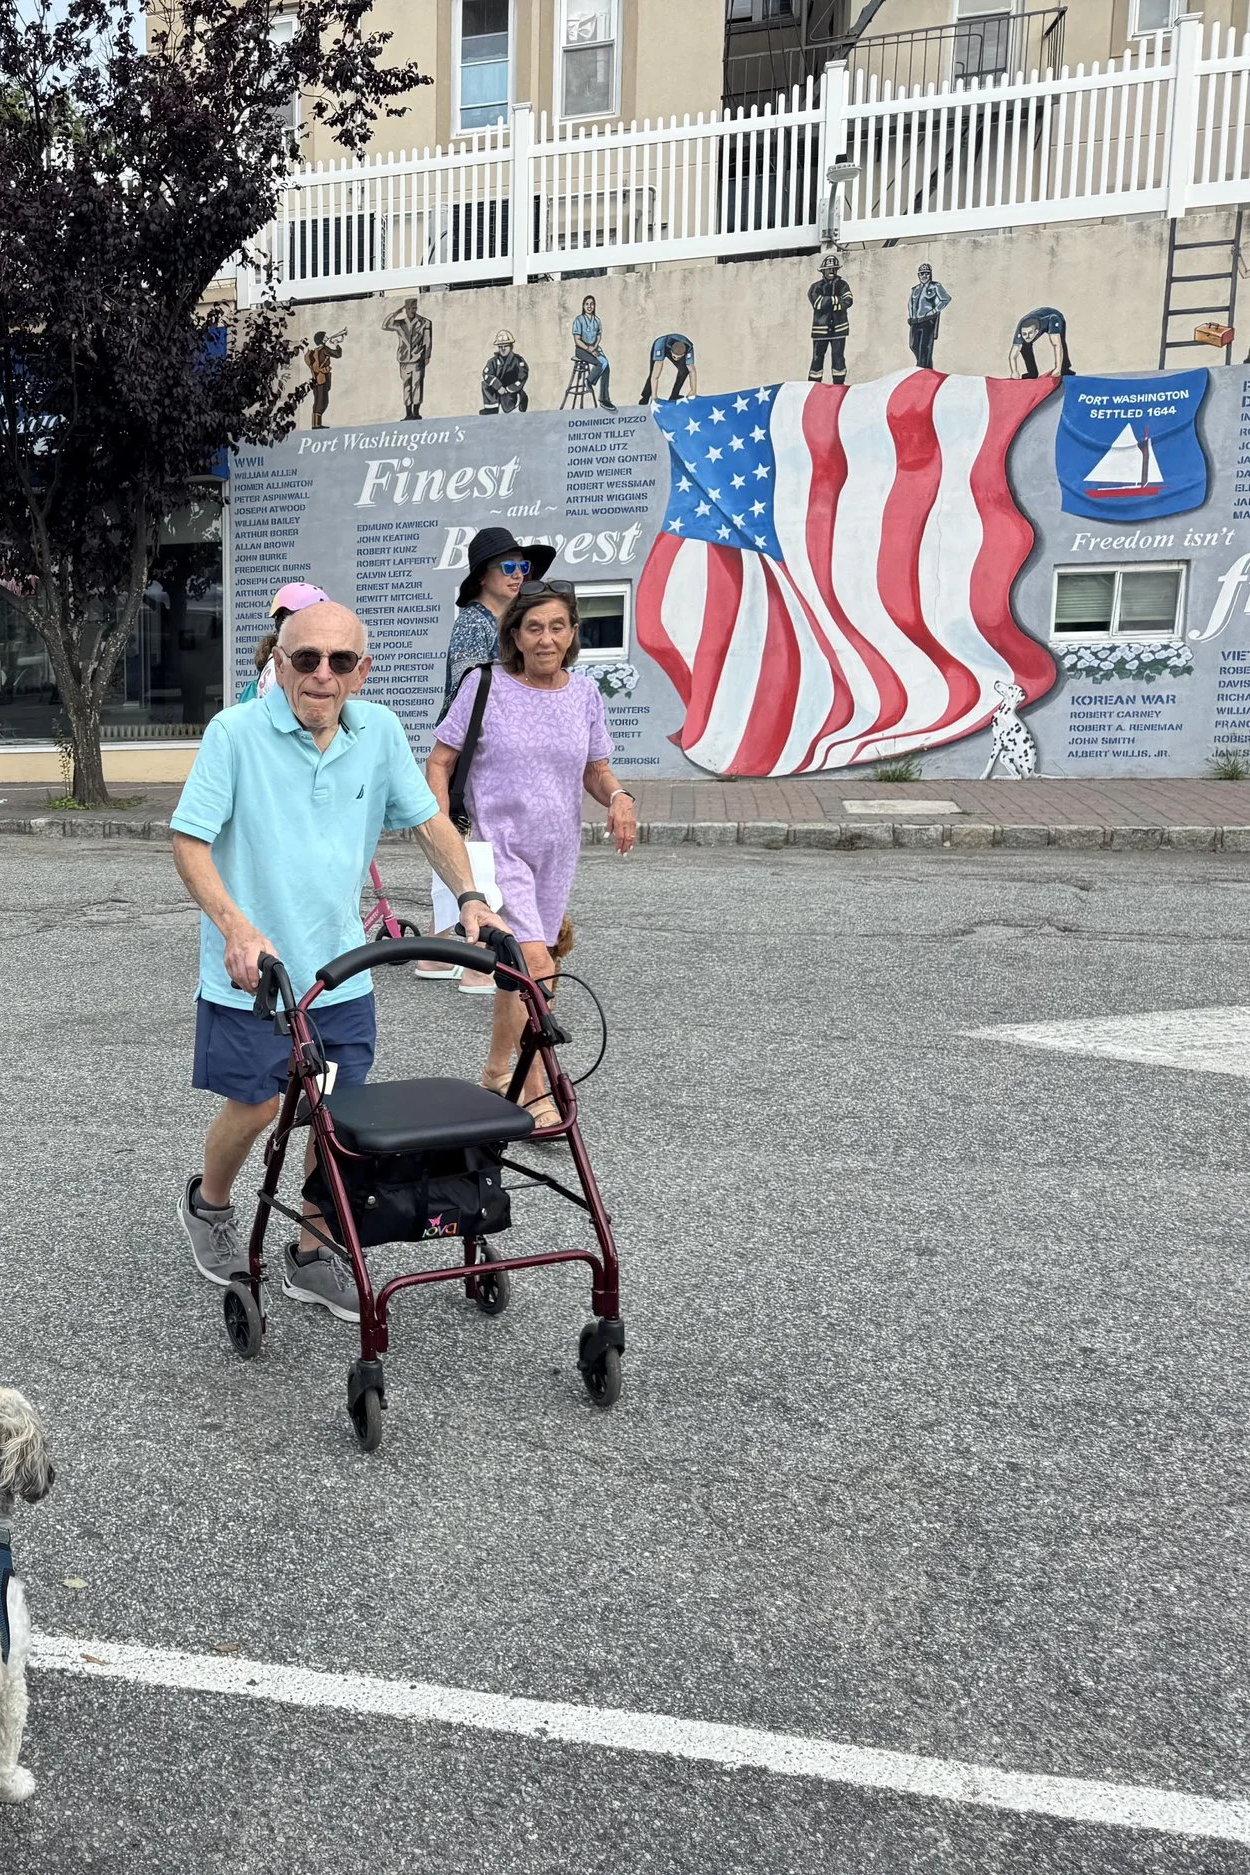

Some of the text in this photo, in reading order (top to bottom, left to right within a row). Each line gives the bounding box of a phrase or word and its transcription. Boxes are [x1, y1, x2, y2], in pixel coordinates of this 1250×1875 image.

[1078, 389, 1189, 405] PORT WASHINGTON
[1090, 406, 1177, 419] SETTLED 1644
[568, 415, 647, 428] DOMINICK PIZZO
[298, 425, 466, 454] Port Washington's
[568, 429, 635, 441] MILTON TILLEY
[567, 442, 628, 454] DONALD UTZ
[234, 456, 264, 468] WWII
[567, 453, 658, 466] JOHN VON GONTEN
[234, 468, 298, 480] WILLIAM ALLEN
[567, 467, 632, 479] DAVID WEINER
[234, 480, 314, 492] HOMER ALLINGTON
[354, 455, 522, 508] Finest
[566, 479, 656, 491] ROBERT WESSMAN
[234, 492, 310, 504] PETER ASPINWALL
[566, 492, 648, 504] ARTHUR WIGGINS
[234, 504, 306, 516] JOSEPH ATWOOD
[507, 501, 541, 518] and
[565, 505, 649, 517] PAUL WOODWARD
[234, 516, 301, 528] WILLIAM BAILEY
[356, 519, 438, 532] EDMUND KAWIECKI
[234, 528, 299, 539] ARTHUR BORER
[356, 533, 420, 544] JOHN KEATING
[1070, 526, 1236, 552] Freedom isn't
[234, 540, 295, 551] ALLAN BROWN
[356, 545, 418, 556] ROBERT KUNZ
[433, 520, 643, 571] Bvest
[235, 552, 288, 562] JOHN BURKE
[356, 556, 437, 568] ROBERT LAFFERTY
[234, 563, 311, 574] FREDERICK BURNS
[356, 569, 412, 580] CALVIN LEITZ
[235, 575, 305, 586] JOSEPH CARUSO
[356, 581, 423, 592] ERNEST MAZUR
[235, 589, 268, 597] ARTHUR
[356, 593, 433, 603] HEWITT MITCHELL
[235, 600, 271, 609] NICHOLA
[355, 604, 441, 615] CHESTER NAKELSKI
[235, 612, 262, 620] JAMES
[362, 616, 439, 626] HESTER NOVINSKI
[235, 624, 275, 632] ANTHONY
[376, 628, 429, 637] PERDREAUX
[383, 641, 413, 649] POOLE
[398, 651, 447, 660] PORCIELLO
[369, 663, 434, 673] WALD PRESTON
[391, 675, 429, 683] RICHTER
[355, 686, 444, 696] RANK ROGOZENSKI
[392, 699, 435, 707] ROSEBRO
[1071, 694, 1176, 706] KOREAN WAR
[608, 706, 650, 714] WINTERS
[1070, 711, 1162, 719] ROBERT CARNEY
[1069, 724, 1113, 732] ROBERT
[1101, 737, 1136, 745] SMITH
[1067, 750, 1171, 758] ALBERT WILLIS, JR.
[612, 757, 660, 765] ZEBROSKI
